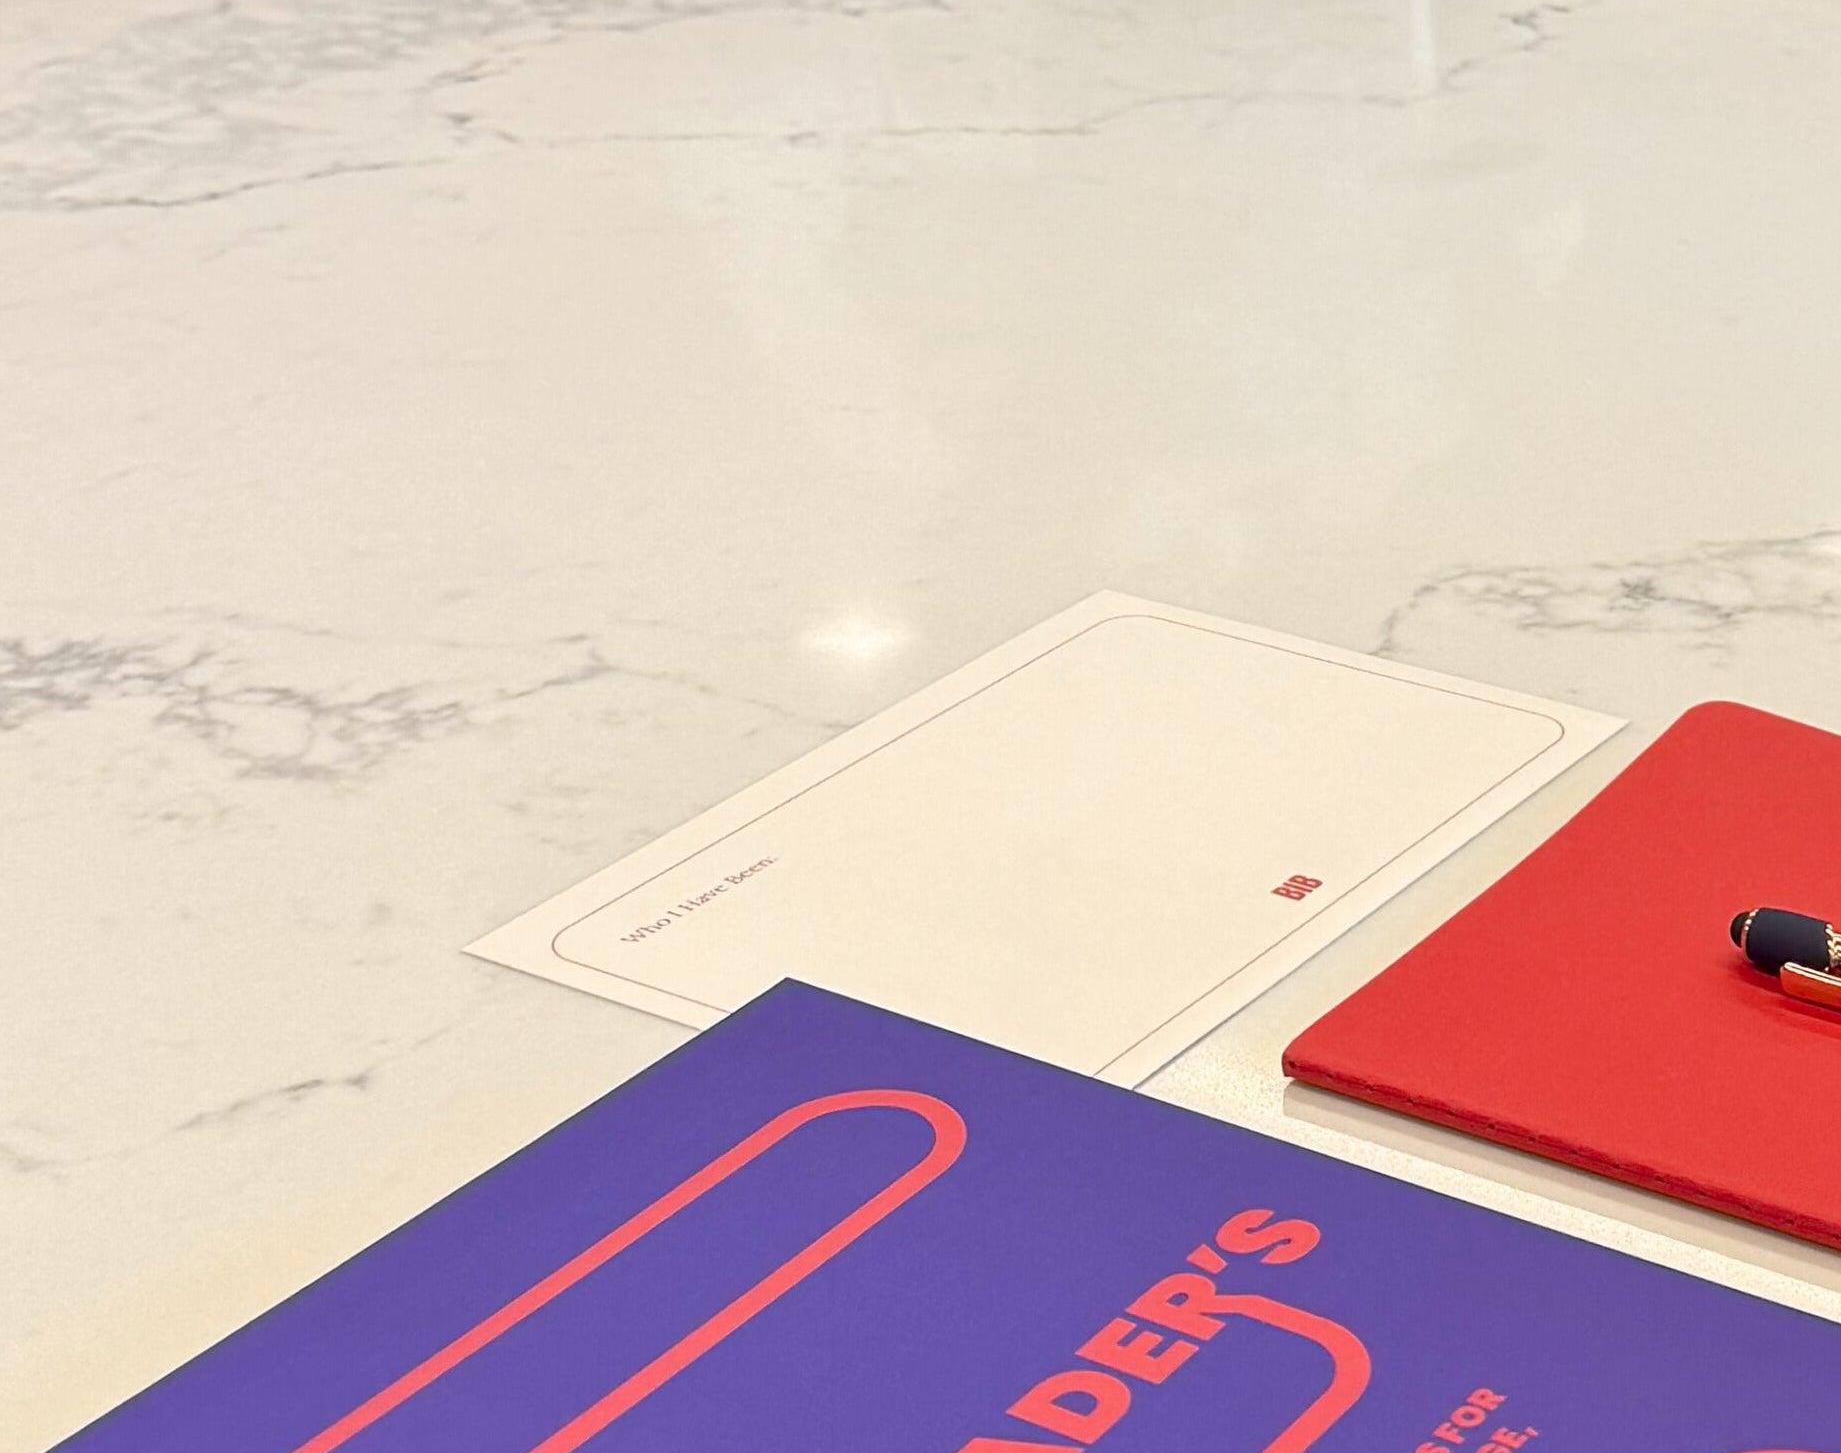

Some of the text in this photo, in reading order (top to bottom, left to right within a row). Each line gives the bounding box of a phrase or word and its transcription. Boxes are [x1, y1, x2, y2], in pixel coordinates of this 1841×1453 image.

[620, 918, 671, 943] Who
[667, 910, 683, 918] I
[677, 884, 729, 912] Have
[1270, 874, 1323, 901] BIB
[1431, 1387, 1507, 1447] FOR
